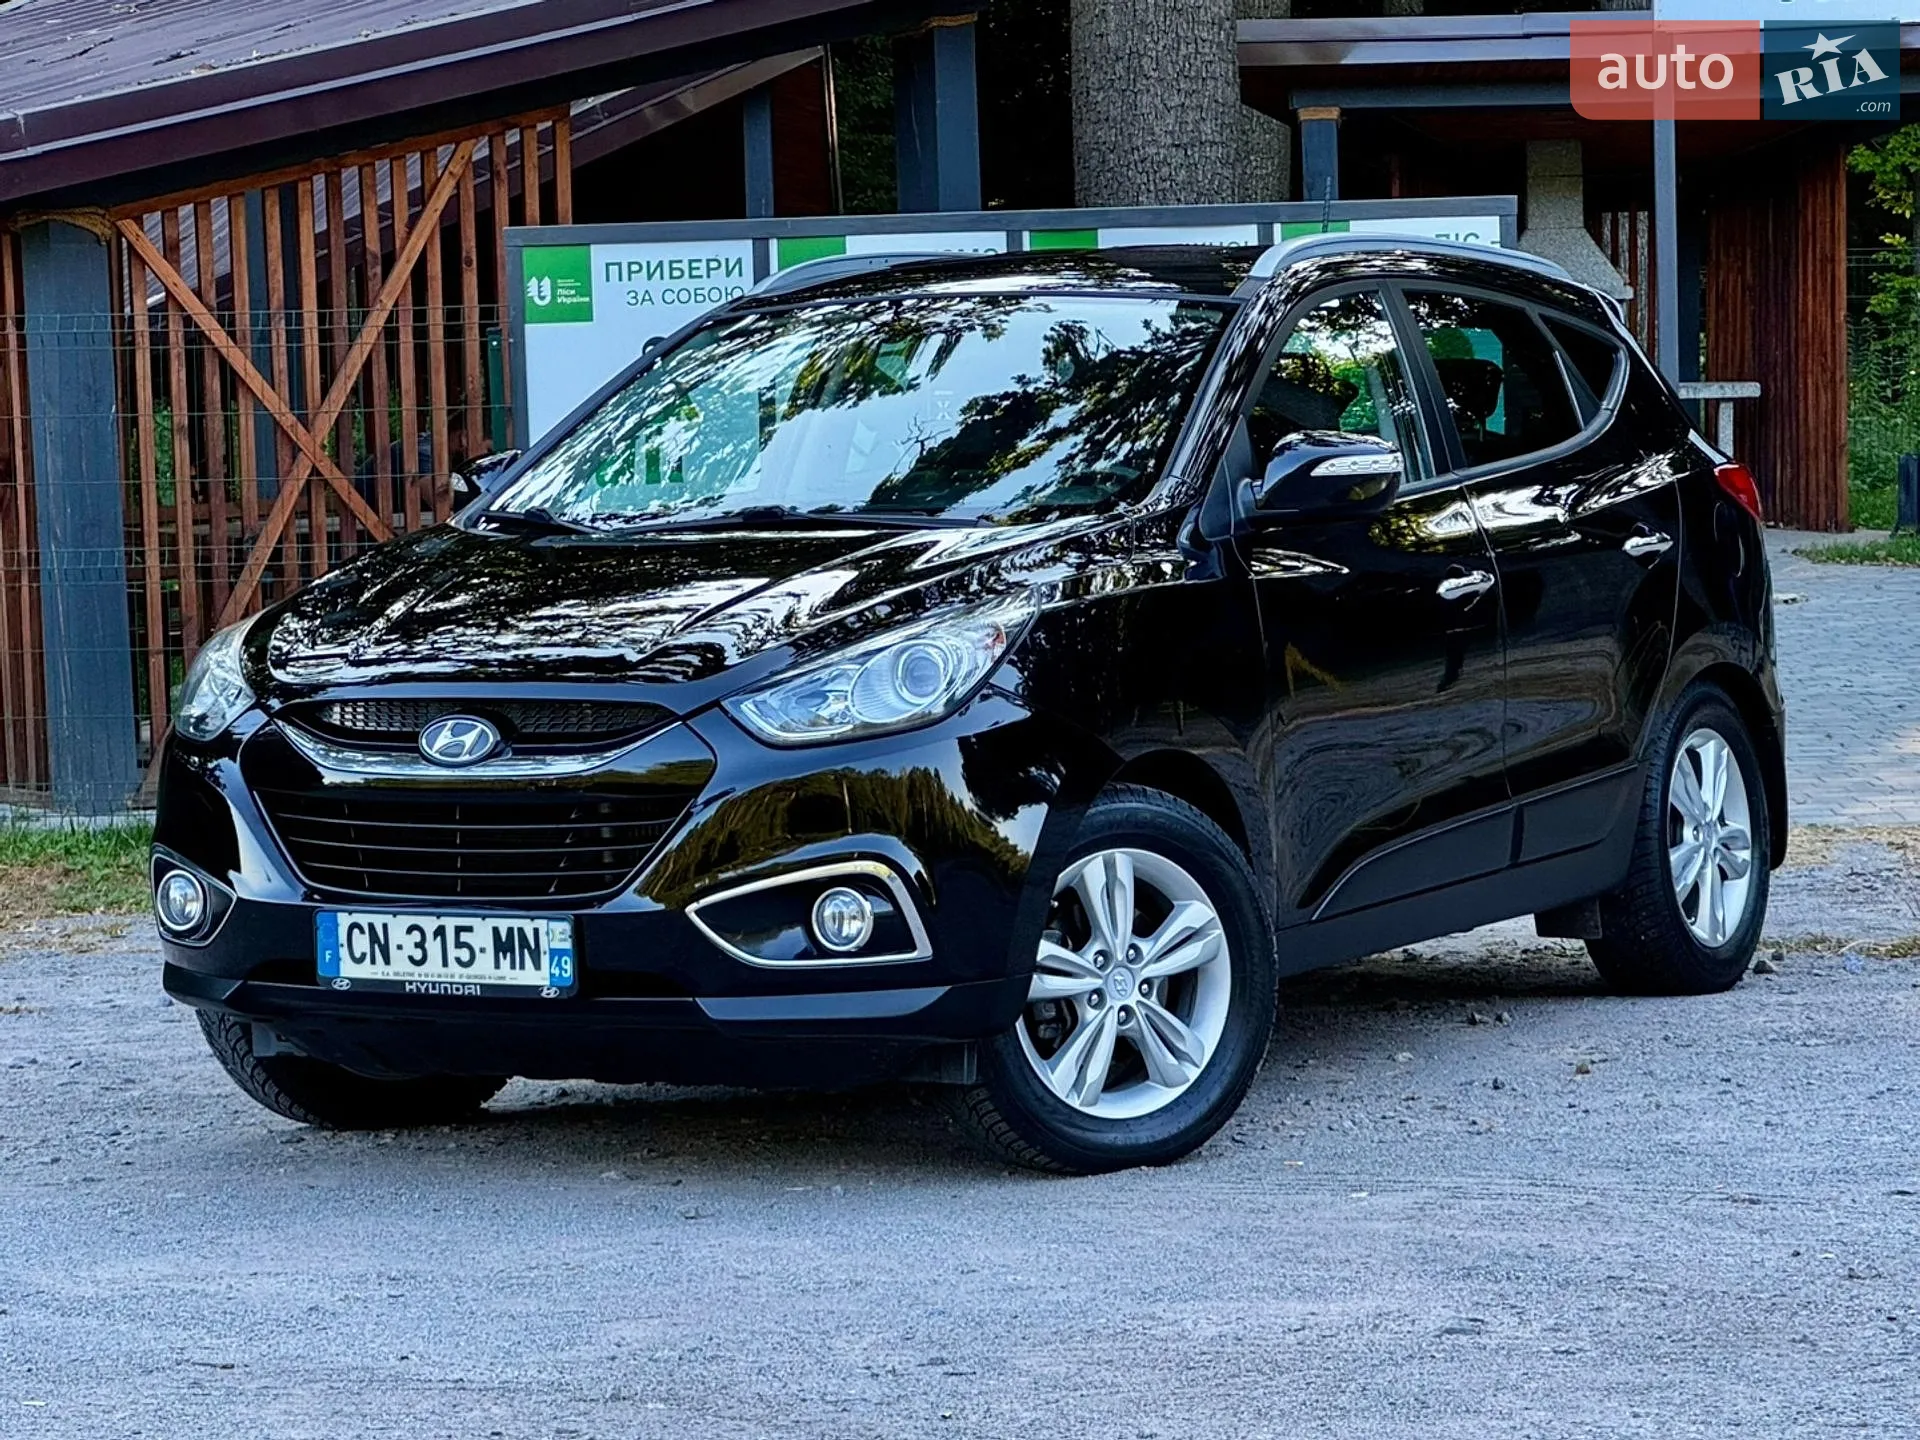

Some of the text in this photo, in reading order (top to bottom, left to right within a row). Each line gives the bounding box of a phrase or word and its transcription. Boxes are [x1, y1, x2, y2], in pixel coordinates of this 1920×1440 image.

[604, 256, 744, 283] ПРИБЕРИ
[626, 286, 744, 306] ЗА СОБОЮ
[324, 950, 332, 963] F
[550, 955, 571, 978] 49
[405, 981, 481, 996] HYUNDAI
